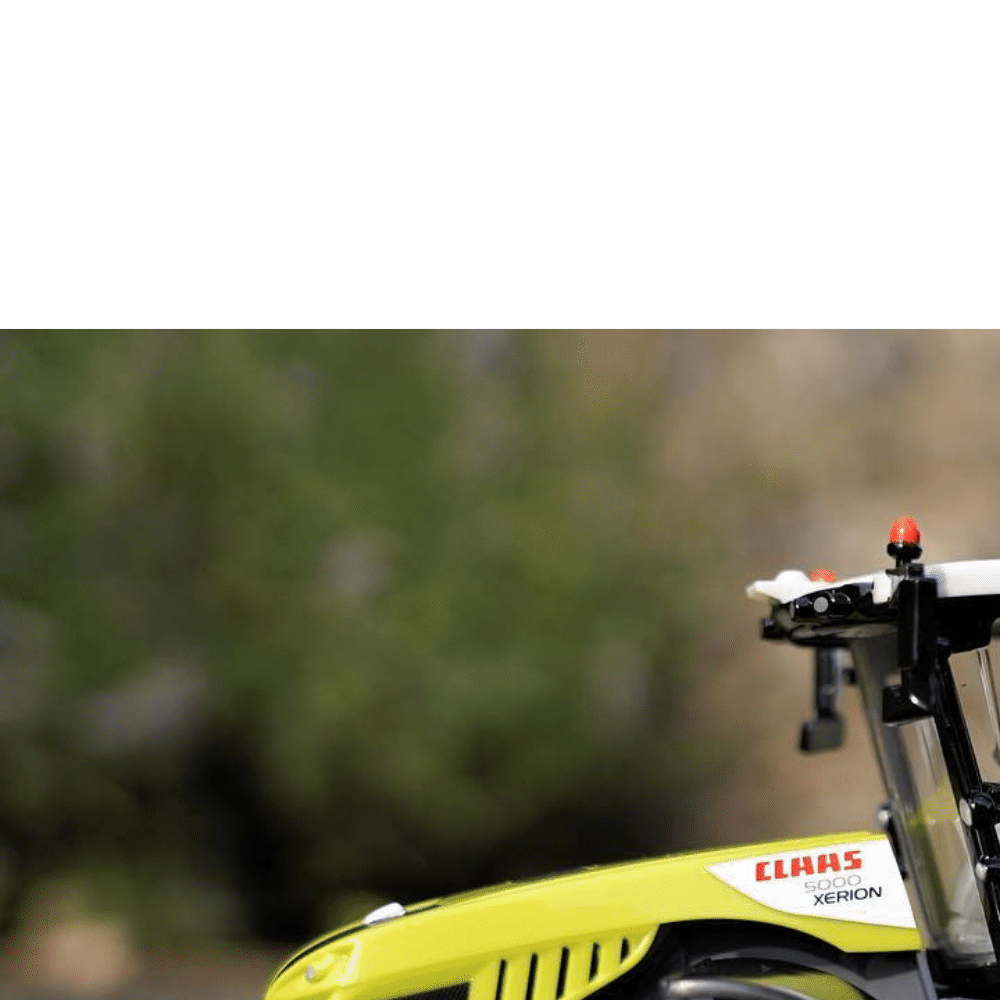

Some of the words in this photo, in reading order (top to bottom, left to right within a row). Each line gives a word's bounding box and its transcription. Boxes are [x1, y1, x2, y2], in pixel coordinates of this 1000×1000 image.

[755, 850, 862, 882] CLAAS
[804, 874, 861, 893] 5000
[813, 886, 882, 906] XERION
